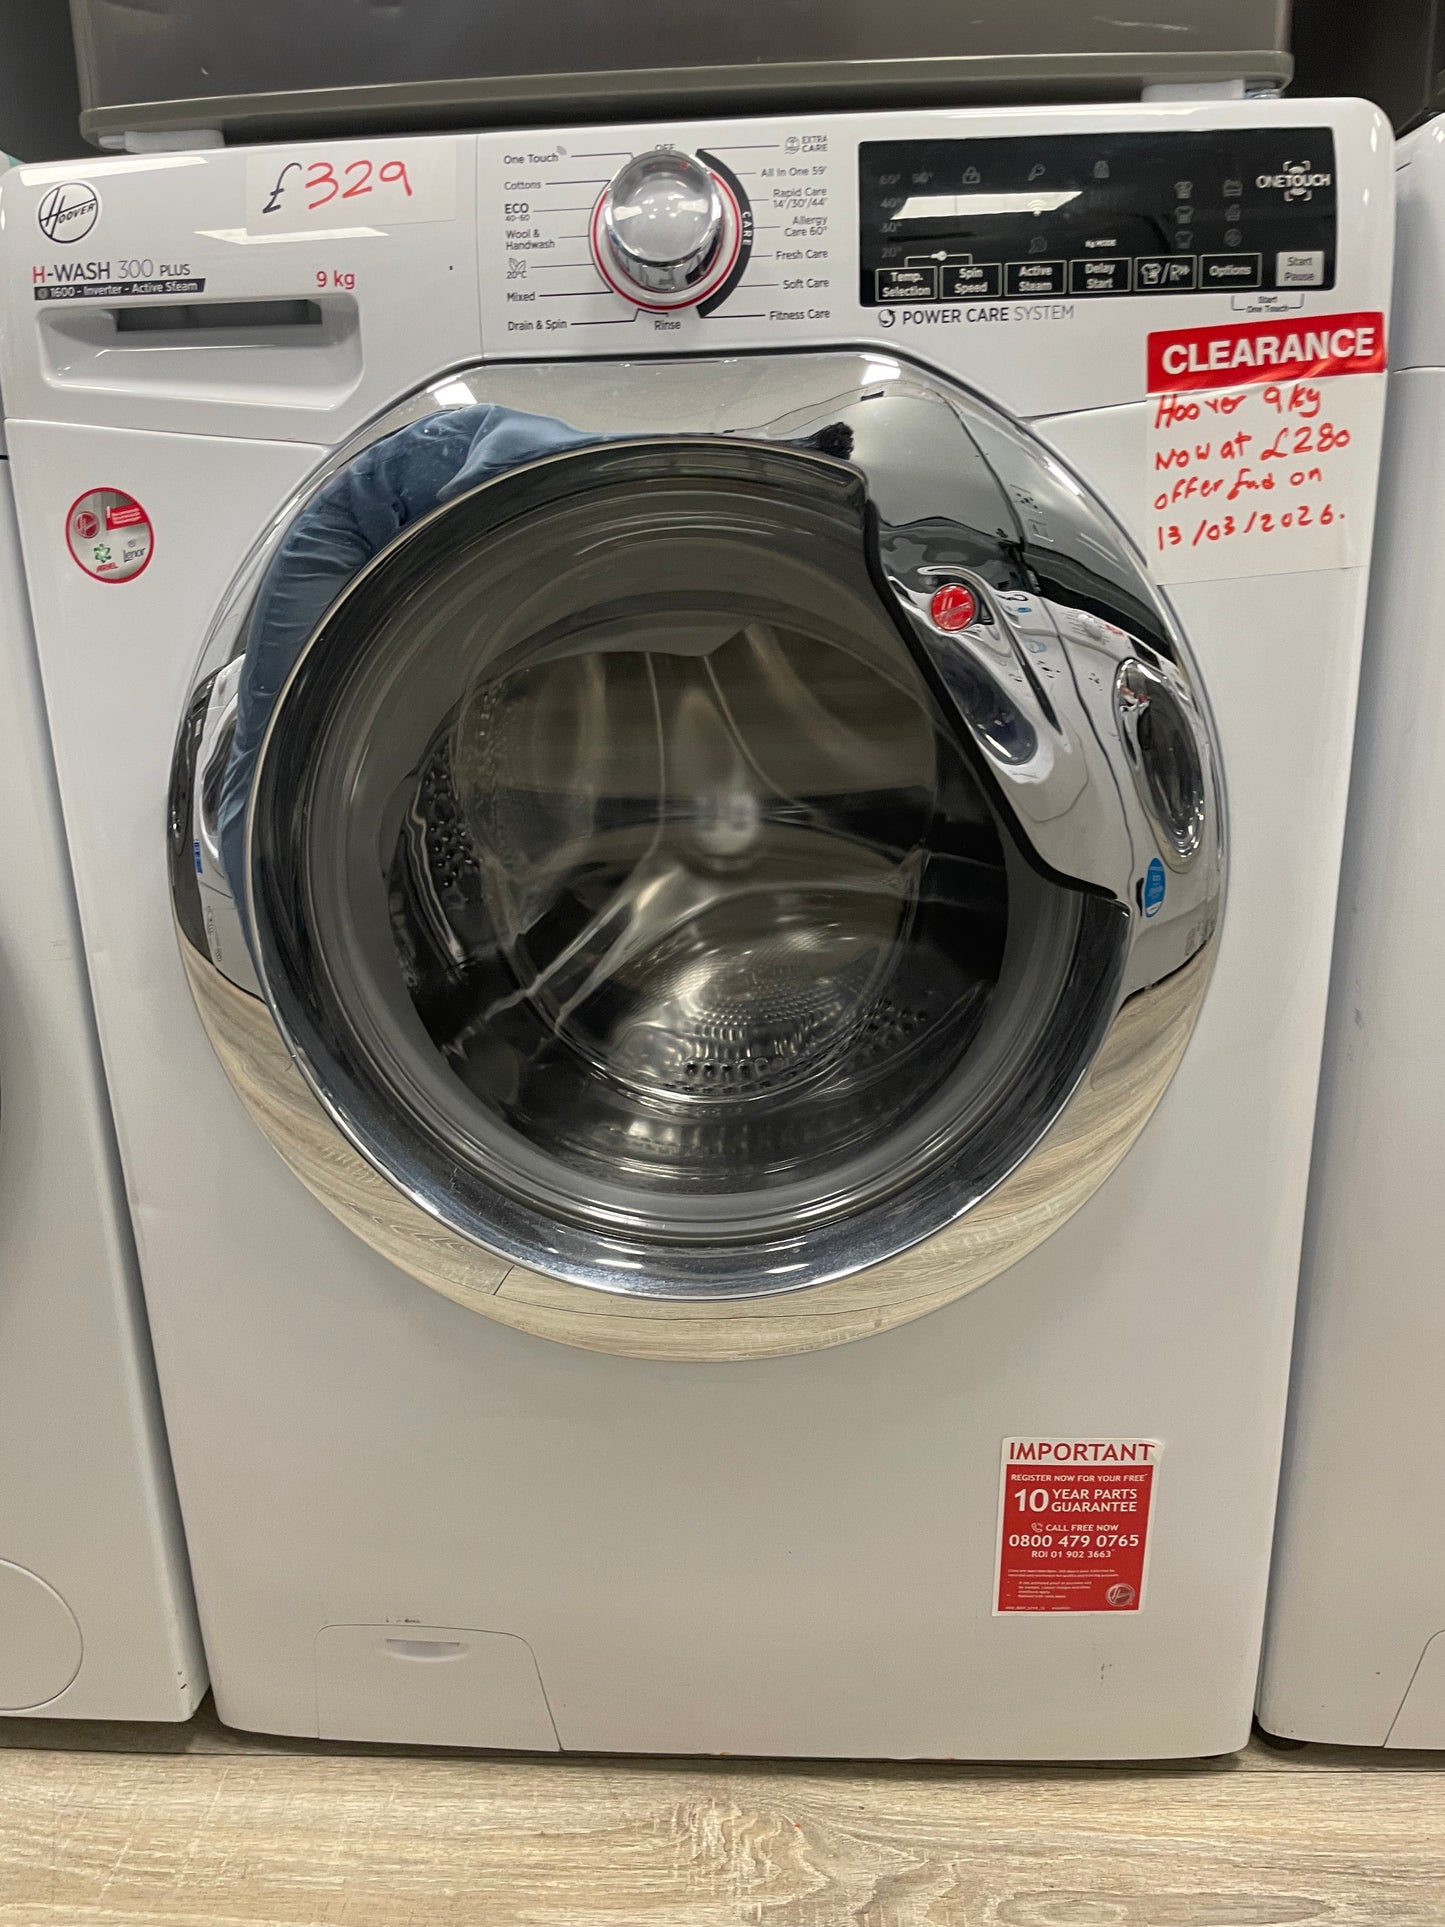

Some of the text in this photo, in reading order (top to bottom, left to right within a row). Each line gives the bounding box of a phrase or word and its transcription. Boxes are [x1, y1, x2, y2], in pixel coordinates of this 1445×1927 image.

[801, 144, 828, 153] CARE
[503, 152, 559, 165] One Touch
[760, 167, 775, 177] All
[776, 167, 787, 177] In
[788, 167, 809, 176] One
[262, 160, 413, 214] £329
[503, 180, 542, 190] Cottons
[772, 187, 828, 198] Rapid Care
[504, 203, 529, 214] ECO
[792, 216, 828, 226] Allergy
[505, 228, 540, 239] Wool &
[741, 211, 754, 246] CARE
[784, 227, 808, 237] Care
[505, 240, 556, 251] Handwash
[775, 249, 829, 260] Fresh Care
[1286, 256, 1313, 267] Start
[32, 258, 191, 284] H-WASH 300 PLUS
[958, 268, 984, 280] Spin
[1018, 265, 1053, 277] Active
[1084, 262, 1116, 276] Delay
[1208, 265, 1253, 278] Options
[316, 269, 356, 290] 9 kg
[890, 271, 924, 283] Temp.
[1284, 271, 1315, 283] Pause
[50, 286, 76, 298] 1600
[83, 285, 122, 296] Inverter
[131, 282, 163, 294] Active
[165, 281, 198, 292] Steam
[782, 278, 830, 290] Soft Care
[953, 282, 989, 295] Speed
[1018, 280, 1053, 292] Steam
[1086, 278, 1114, 290] Start
[507, 291, 536, 302] Mixed
[882, 286, 931, 298] Selection
[768, 308, 831, 321] Fitness Care
[902, 304, 1074, 325] POWER CARE SYSTEM
[507, 319, 568, 331] Drain & Spin
[654, 319, 681, 331] Rinse
[1161, 326, 1375, 376] CLEARANCE
[1263, 385, 1282, 414] 9
[1220, 430, 1252, 459] at
[1260, 421, 1351, 461] £280
[1289, 466, 1322, 487] on
[1009, 1442, 1156, 1461] IMPORTANT
[1010, 1474, 1052, 1483] REGISTER
[1053, 1475, 1076, 1483] NOW
[1077, 1475, 1095, 1483] FOR
[1097, 1475, 1121, 1483] YOUR
[1014, 1488, 1138, 1513] 10 YEAR PARTS
[1051, 1501, 1138, 1513] GUARANTEE
[1045, 1524, 1120, 1532] CALL FREE NOW
[1008, 1534, 1139, 1548] 0800 479 0765
[1031, 1550, 1112, 1558] ROI 01 902 3663
